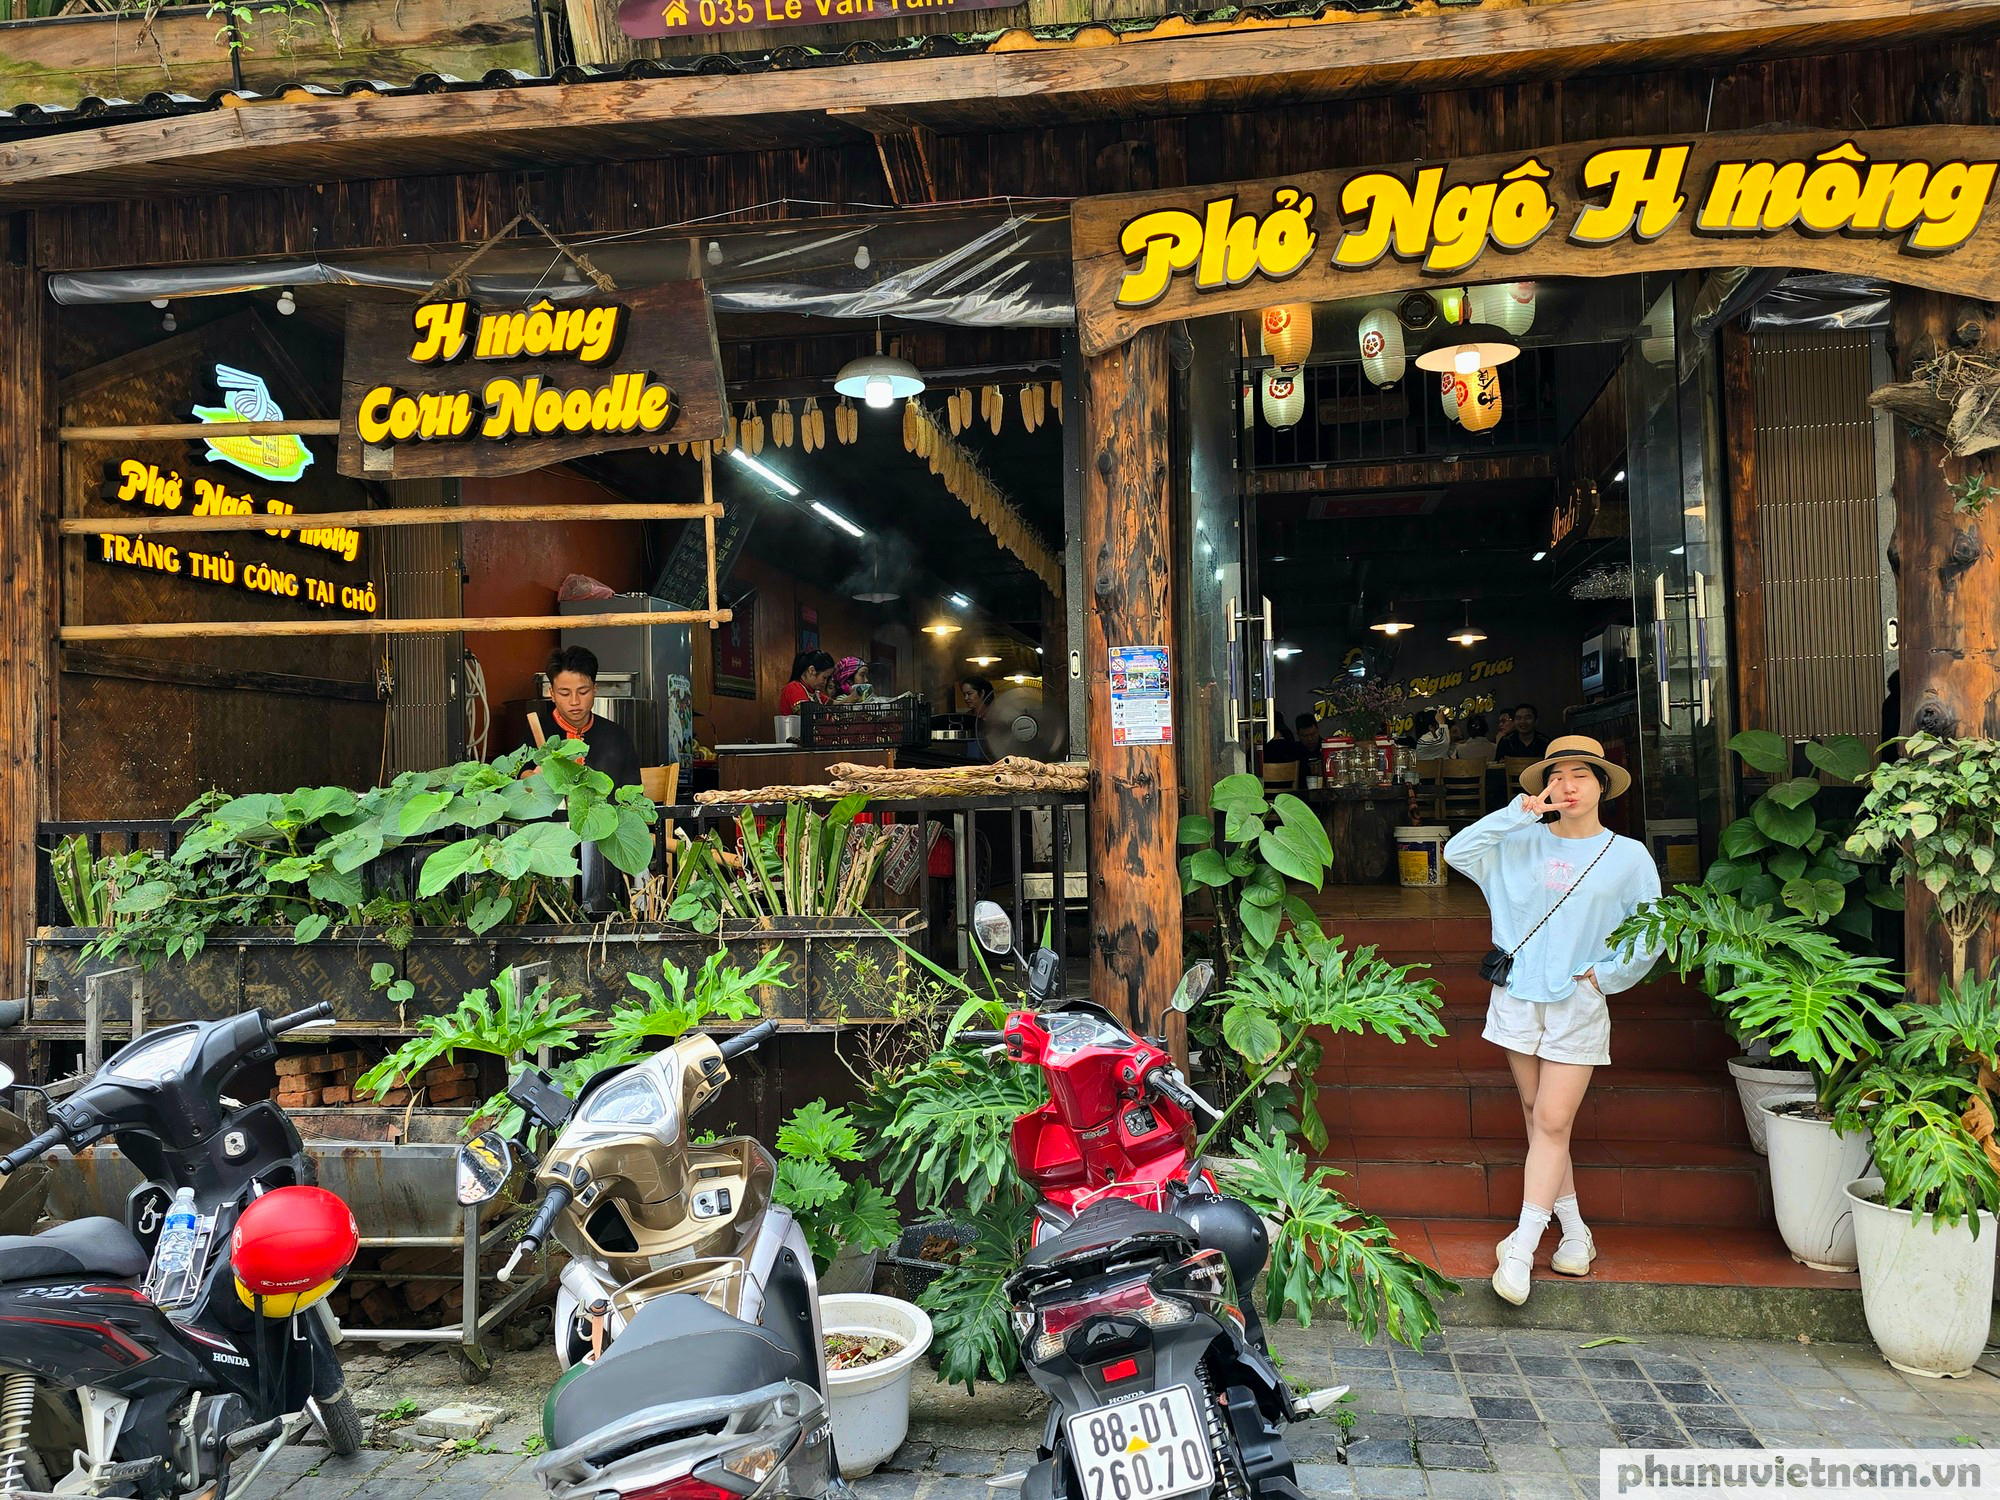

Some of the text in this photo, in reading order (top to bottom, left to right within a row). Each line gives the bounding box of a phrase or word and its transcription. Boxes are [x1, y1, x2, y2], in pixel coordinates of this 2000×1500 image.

[699, 0, 753, 26] 035
[1115, 142, 1998, 306] Phở Ngô H mông
[410, 298, 619, 363] H mông
[358, 372, 671, 443] Corn Noodle
[117, 459, 183, 510] Phở
[99, 533, 377, 613] TRÁNG THỦ CÔNG TẠI CHỖ
[276, 1278, 310, 1287] KYMCO
[212, 1352, 250, 1367] HONDA
[1108, 1389, 1146, 1405] HONDA
[1089, 1396, 1178, 1458] 88-D1
